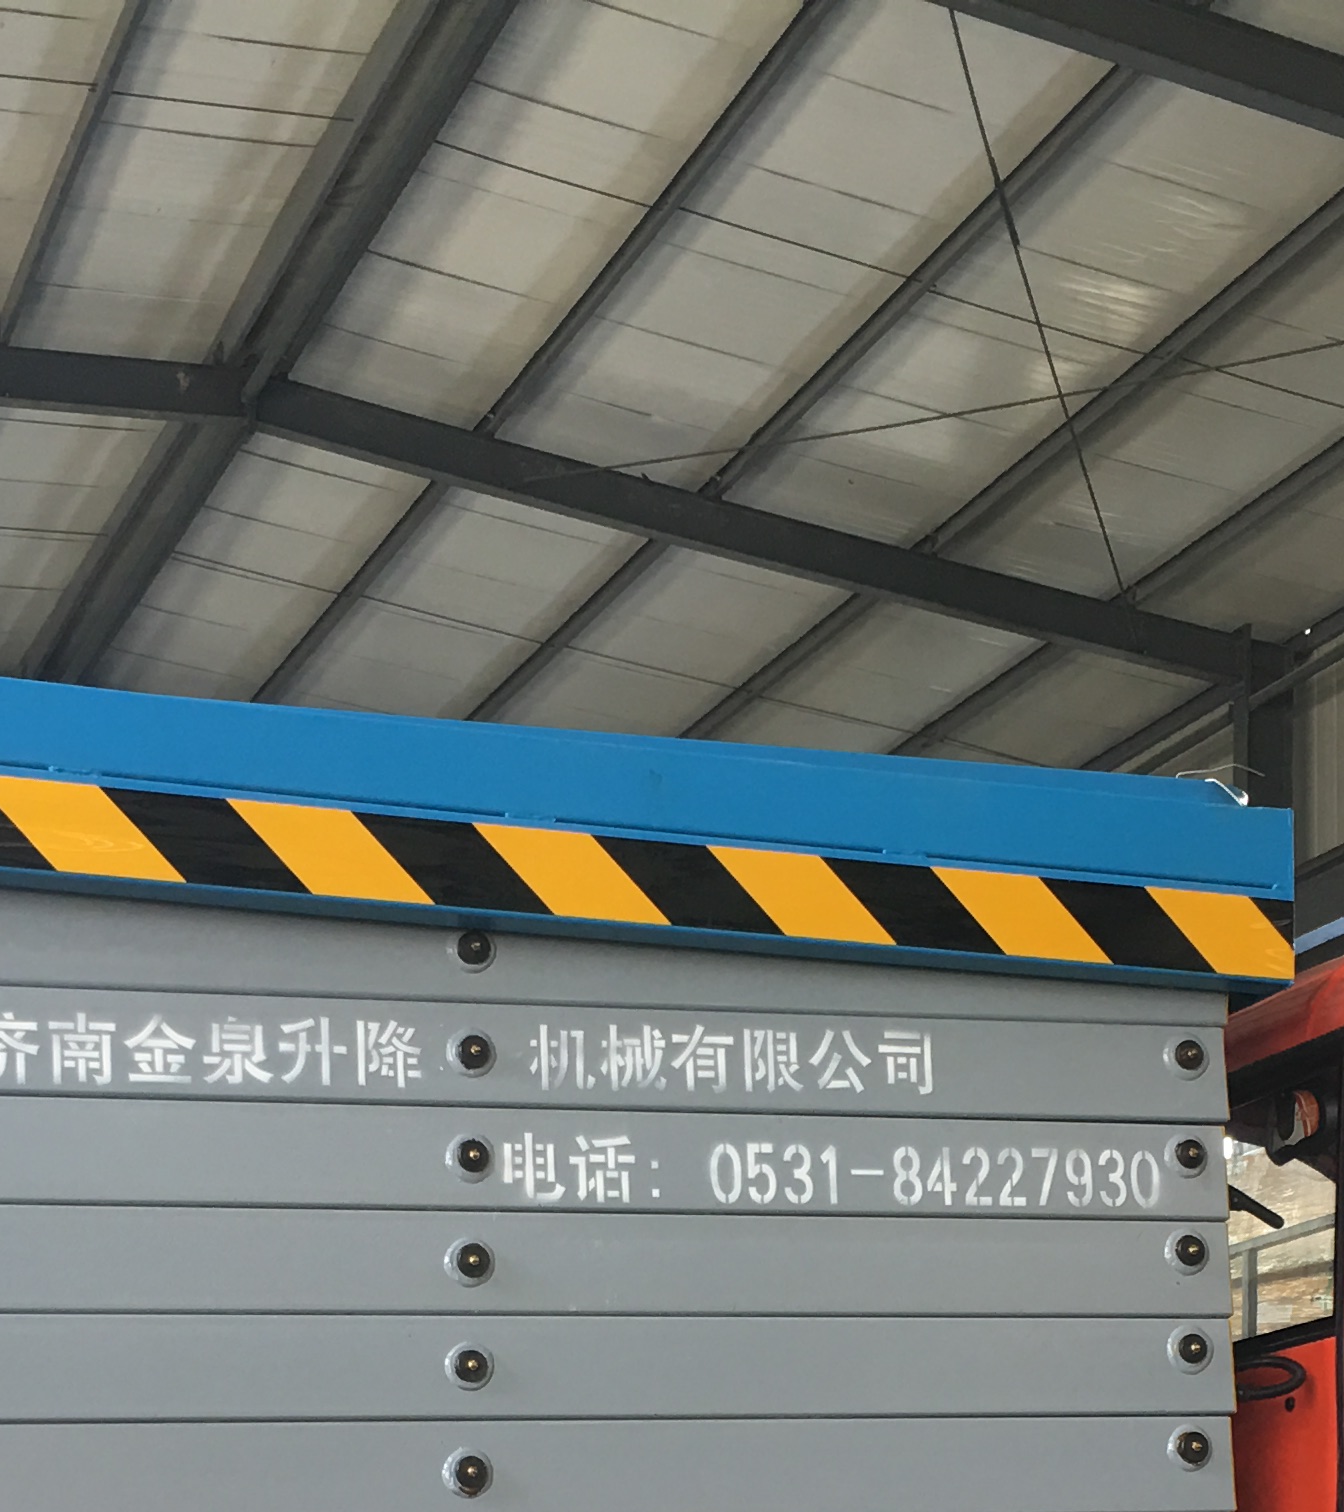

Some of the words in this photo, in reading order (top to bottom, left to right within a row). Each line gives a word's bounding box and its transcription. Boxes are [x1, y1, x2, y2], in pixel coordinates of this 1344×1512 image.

[529, 1022, 935, 1096] 机械有限公司
[708, 1142, 1162, 1209] 0531-84227930
